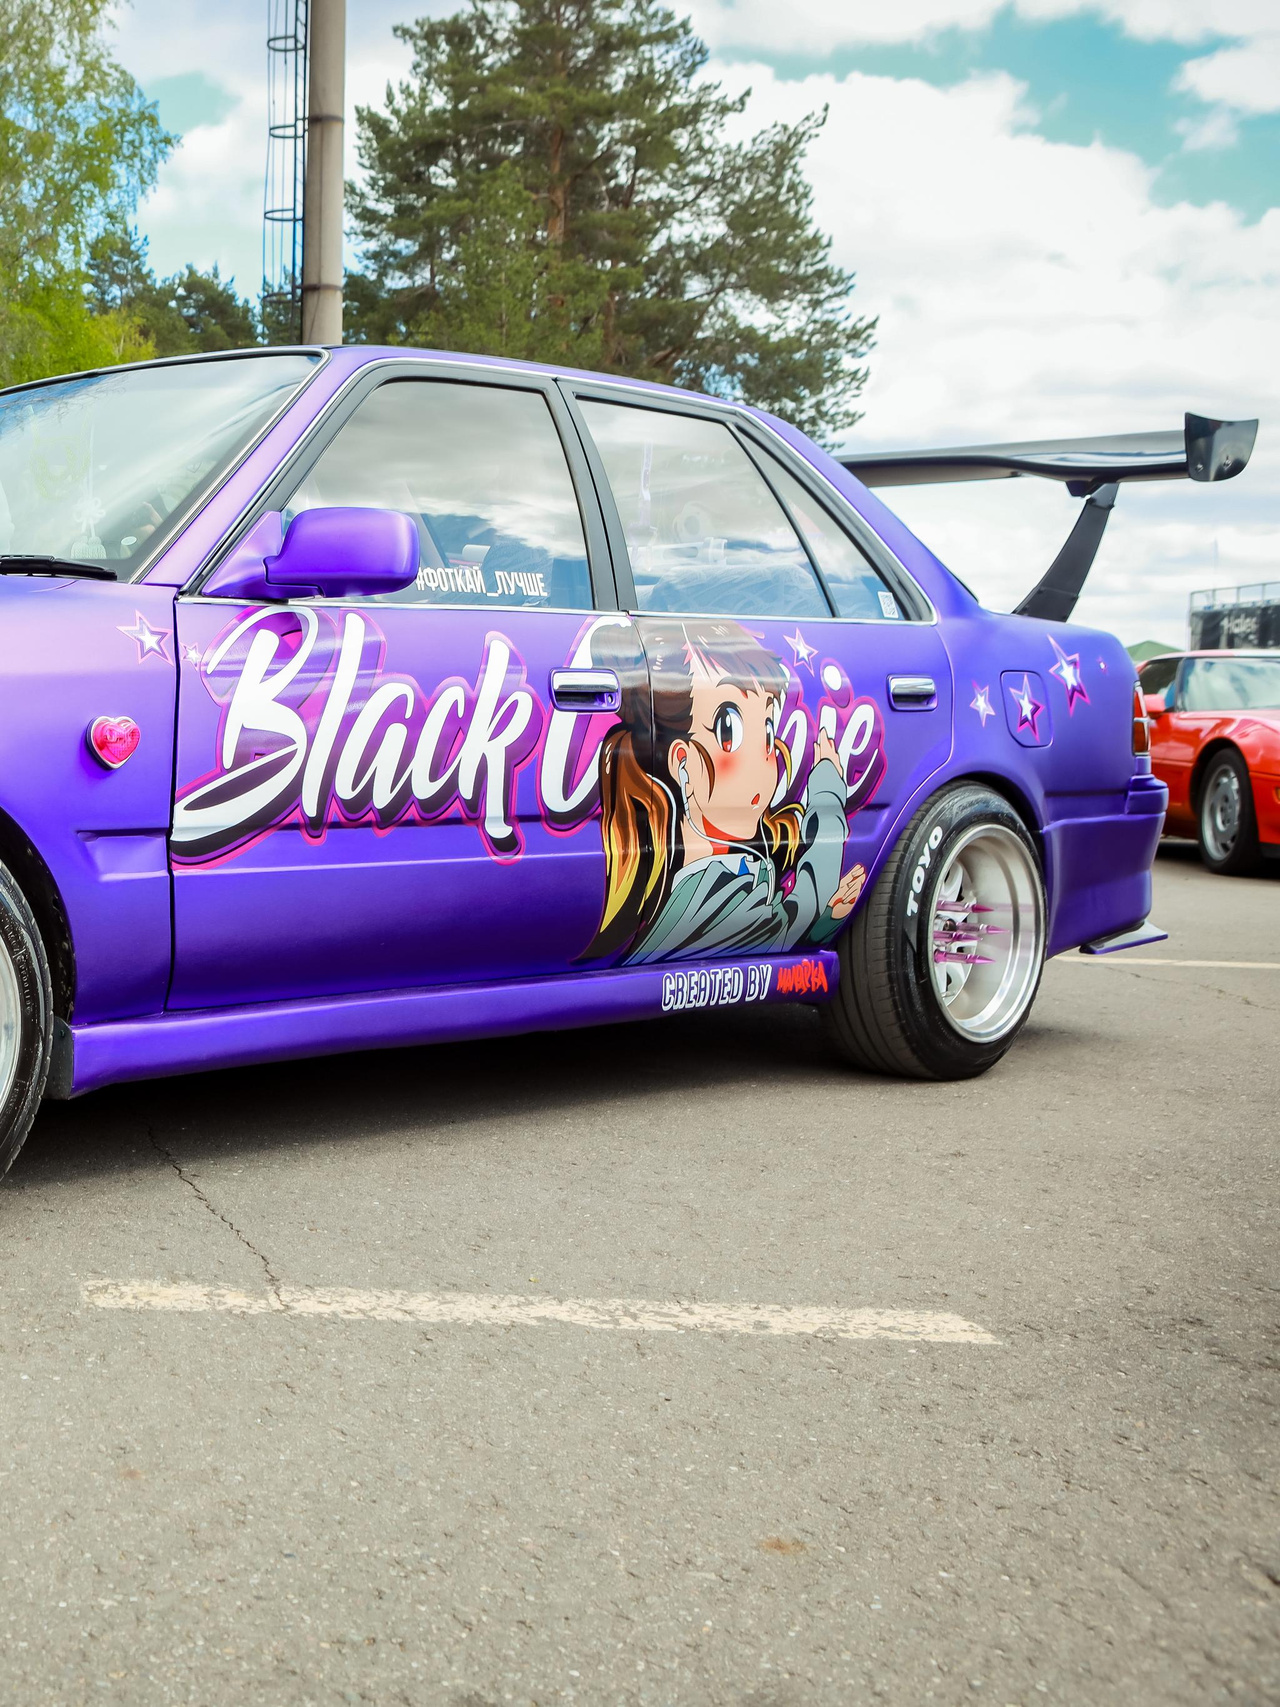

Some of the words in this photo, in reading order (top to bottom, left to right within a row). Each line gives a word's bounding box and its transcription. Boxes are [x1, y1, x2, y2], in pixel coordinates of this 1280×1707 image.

[170, 605, 534, 840] Black
[906, 825, 943, 917] TOYO
[661, 966, 744, 1011] CREATED
[745, 964, 772, 1001] BY
